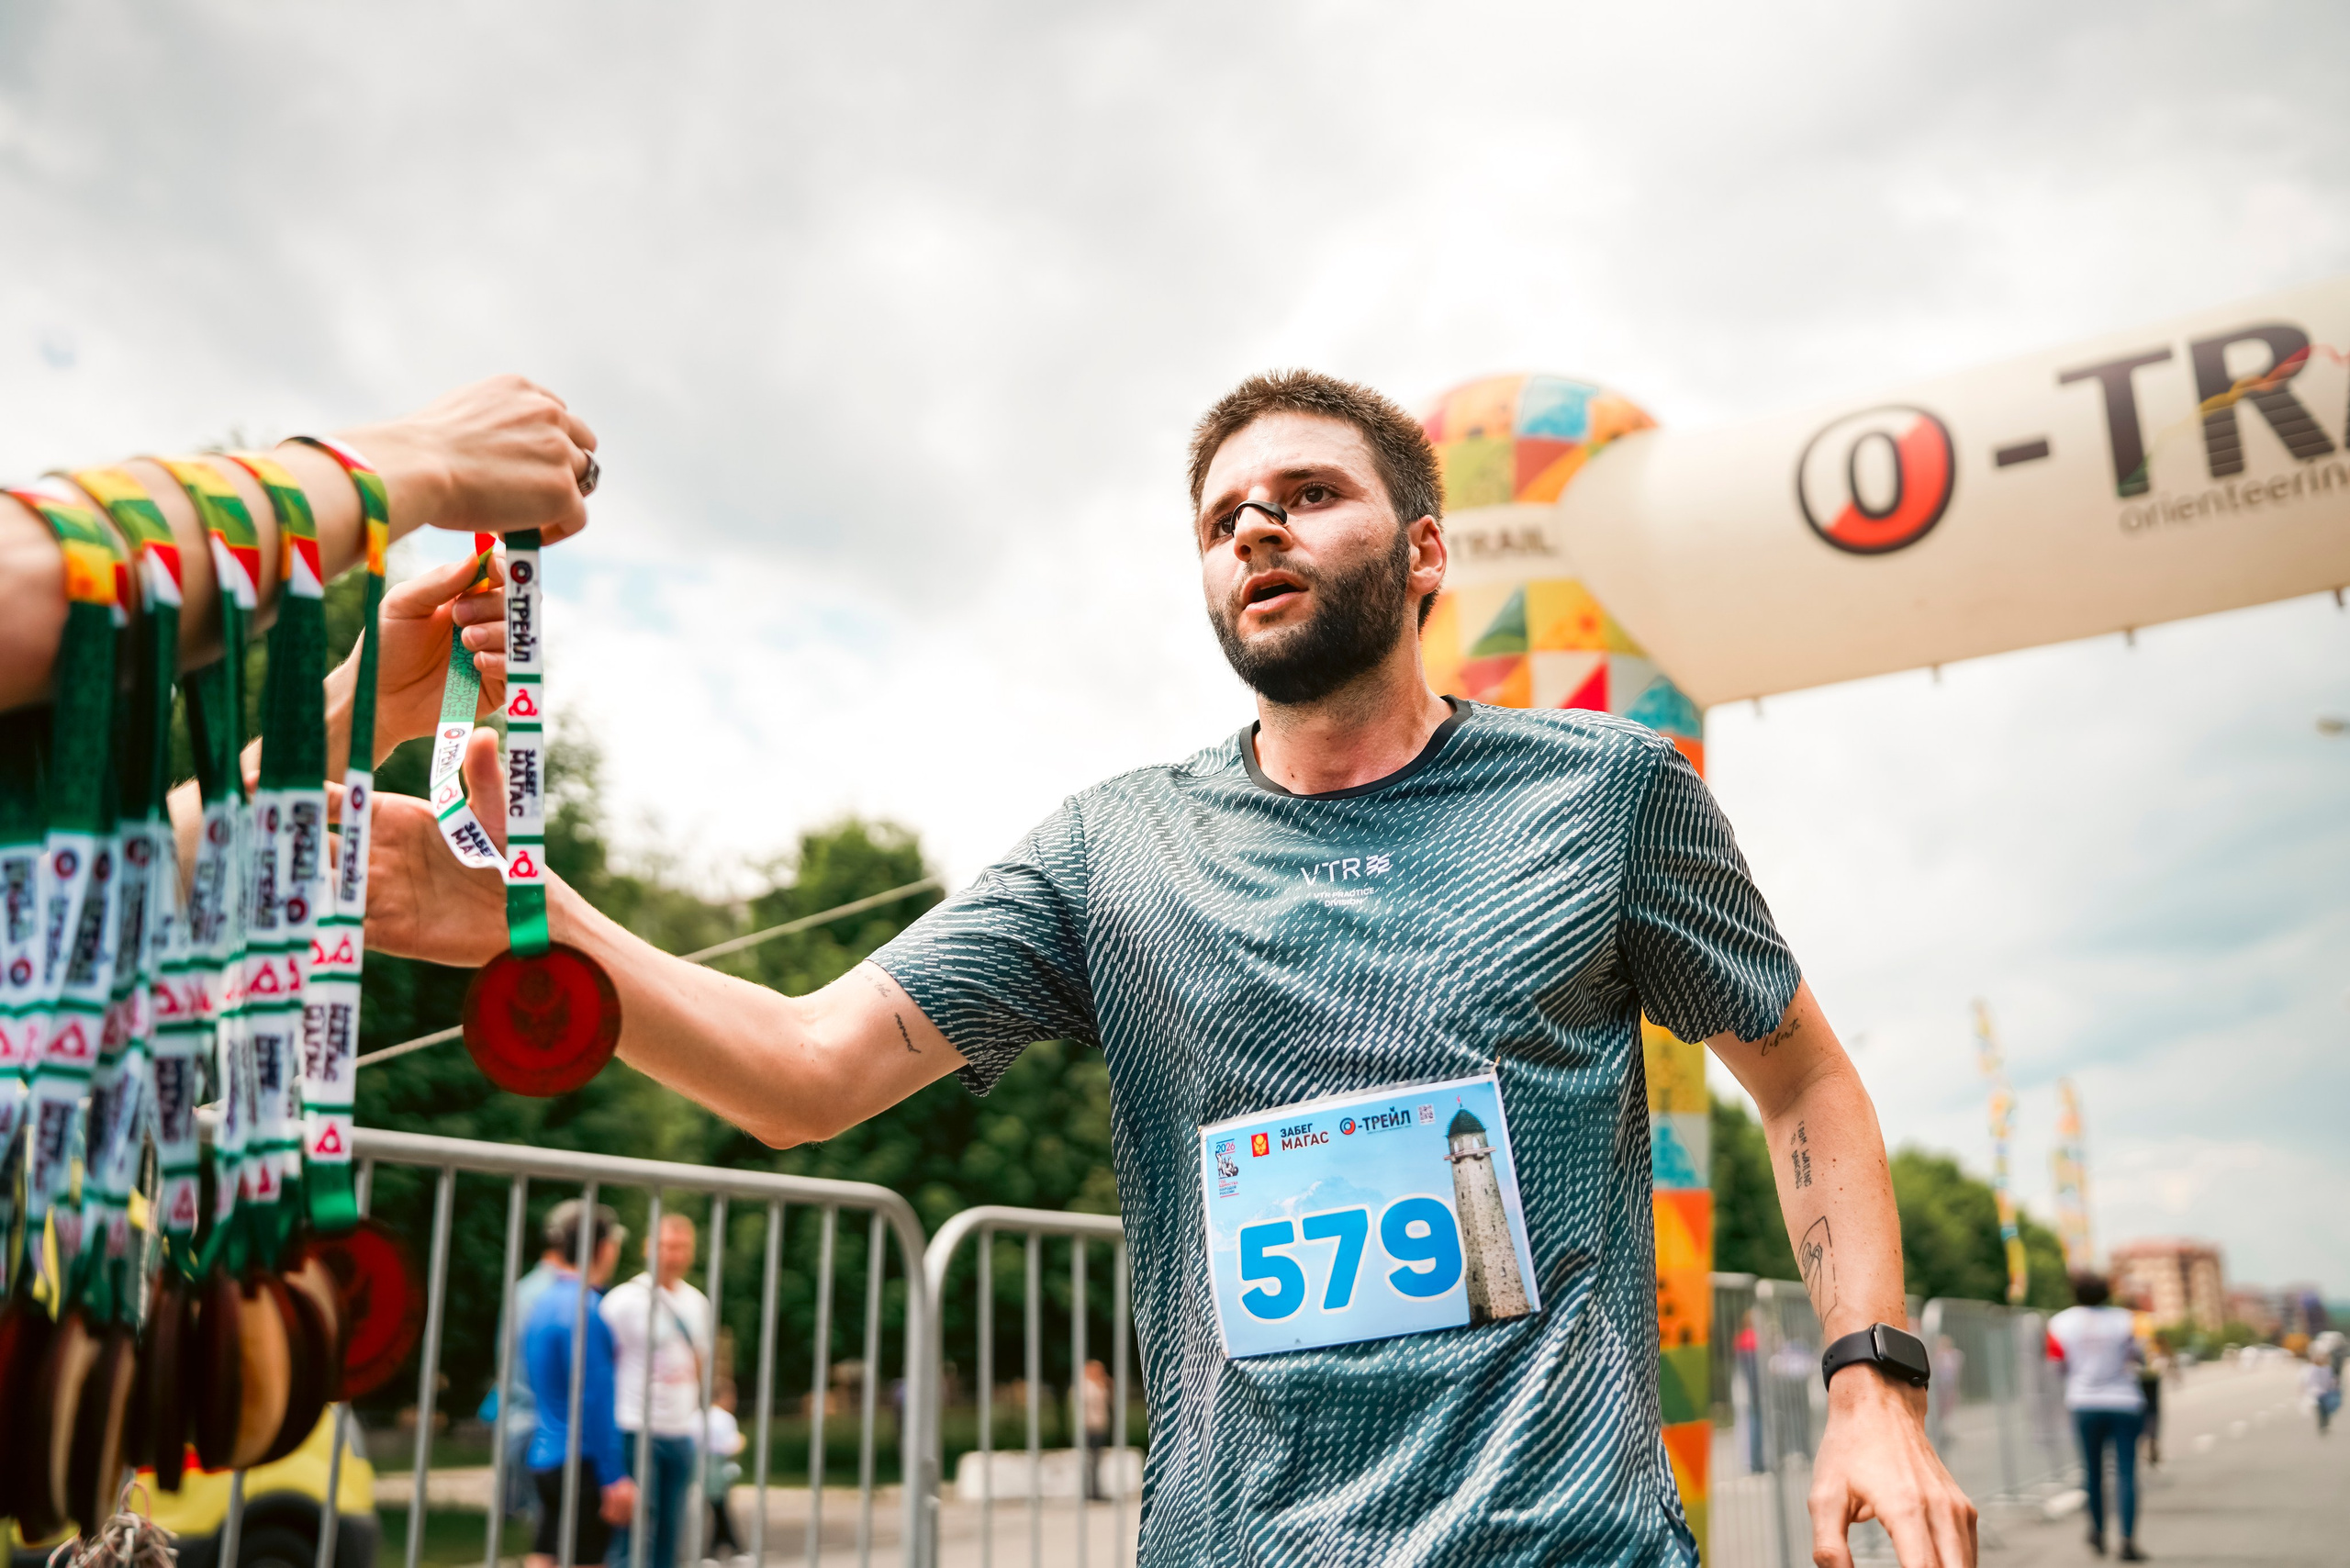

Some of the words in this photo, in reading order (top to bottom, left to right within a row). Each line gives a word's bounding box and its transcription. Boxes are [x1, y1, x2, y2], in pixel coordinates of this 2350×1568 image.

[509, 749, 525, 817] МАГАС
[1300, 857, 1361, 886] VTR
[1325, 898, 1364, 907] DIVISION
[1332, 888, 1375, 898] PRACTICE
[1281, 1123, 1313, 1138] ЗАБЕГ
[1798, 1121, 1807, 1146] FROM
[1215, 1141, 1236, 1154] 2026
[1281, 1131, 1329, 1151] МАГАС
[1238, 1195, 1464, 1322] 579
